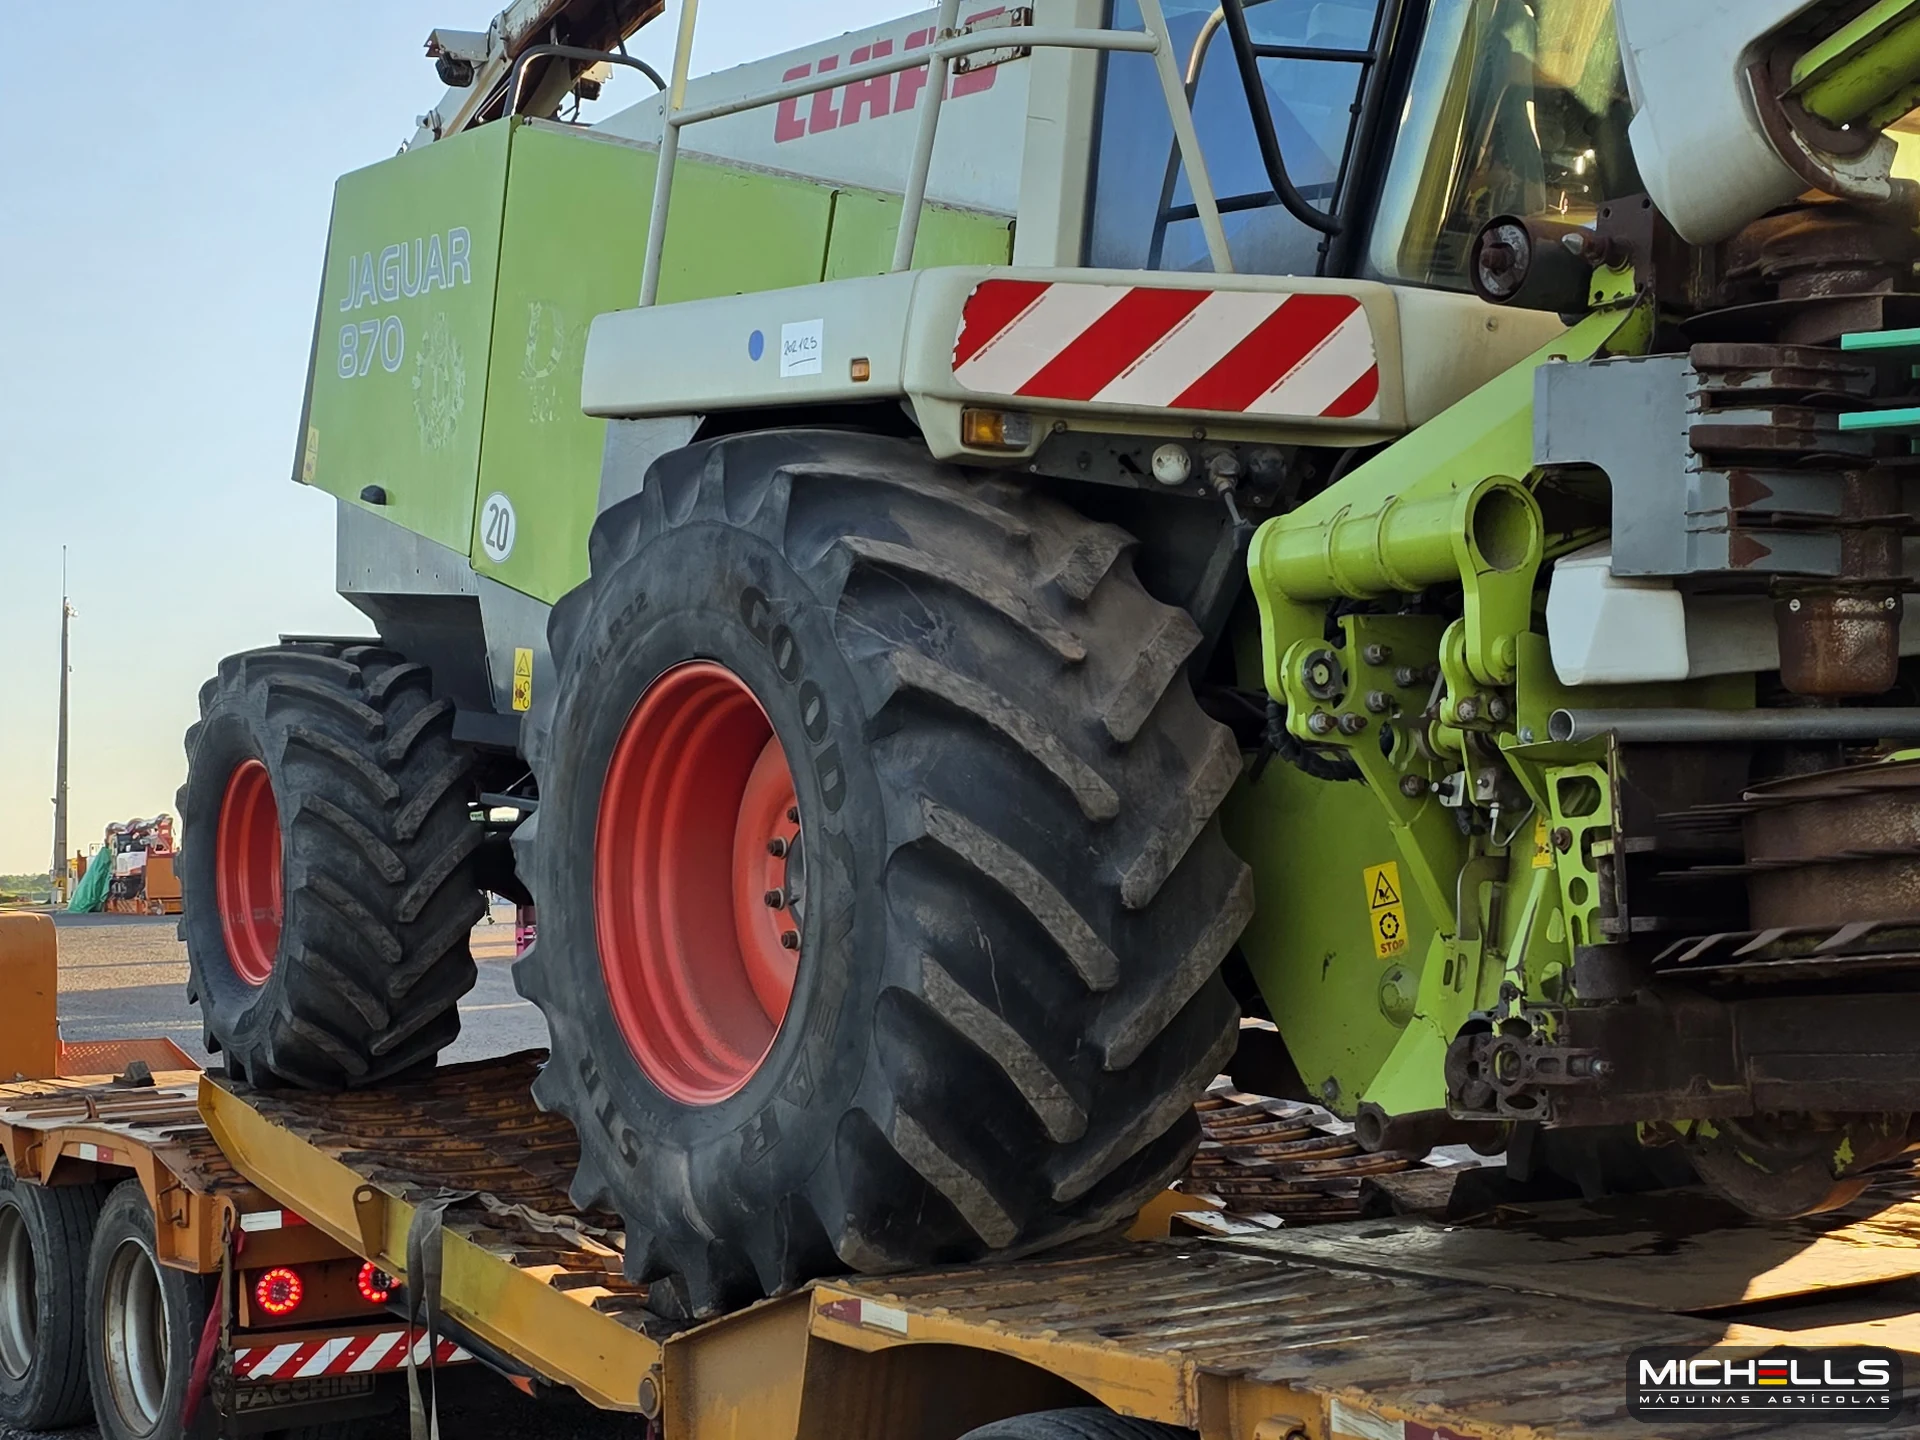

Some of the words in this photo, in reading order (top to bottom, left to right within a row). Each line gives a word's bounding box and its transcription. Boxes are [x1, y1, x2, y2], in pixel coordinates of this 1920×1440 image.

[340, 226, 471, 312] JAGUAR
[338, 315, 405, 379] 870
[485, 503, 510, 552] 20
[1380, 939, 1405, 954] STOP
[235, 1374, 369, 1409] FACCHINI
